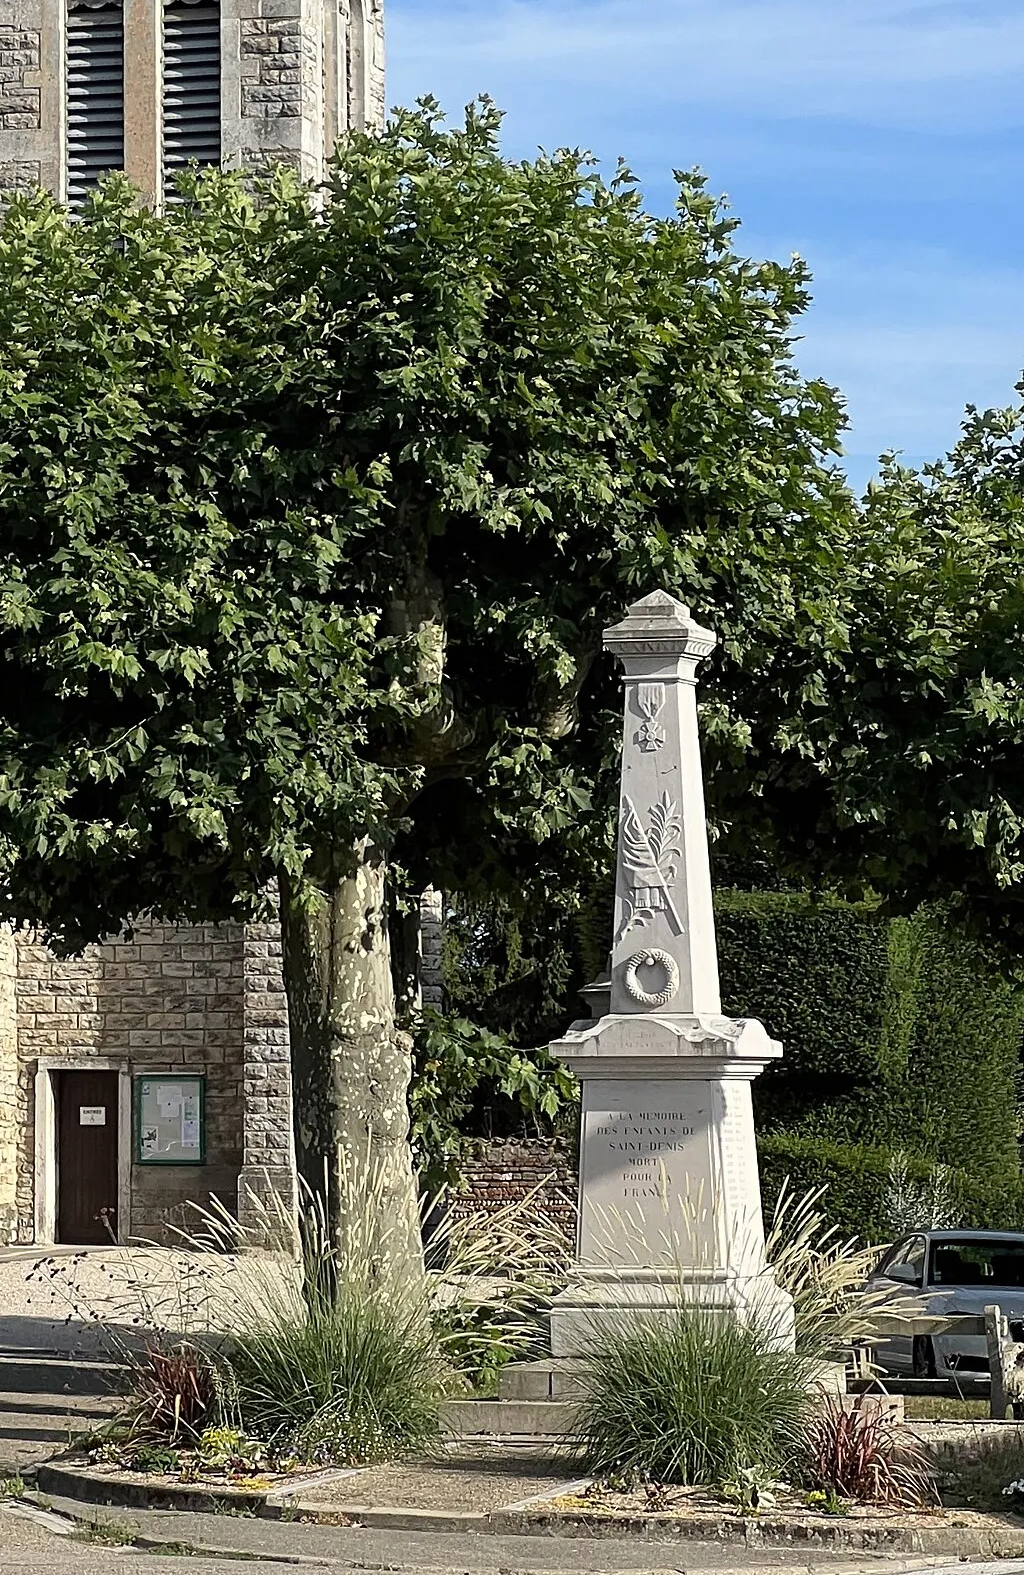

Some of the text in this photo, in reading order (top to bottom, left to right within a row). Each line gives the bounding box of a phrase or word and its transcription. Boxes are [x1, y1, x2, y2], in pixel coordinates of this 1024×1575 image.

[619, 1112, 634, 1121] LA
[596, 1127, 697, 1135] DES ENFANTS DE
[609, 1142, 684, 1151] SAINT-DENIS
[628, 1158, 664, 1166] MORT
[622, 1173, 652, 1181] POUR
